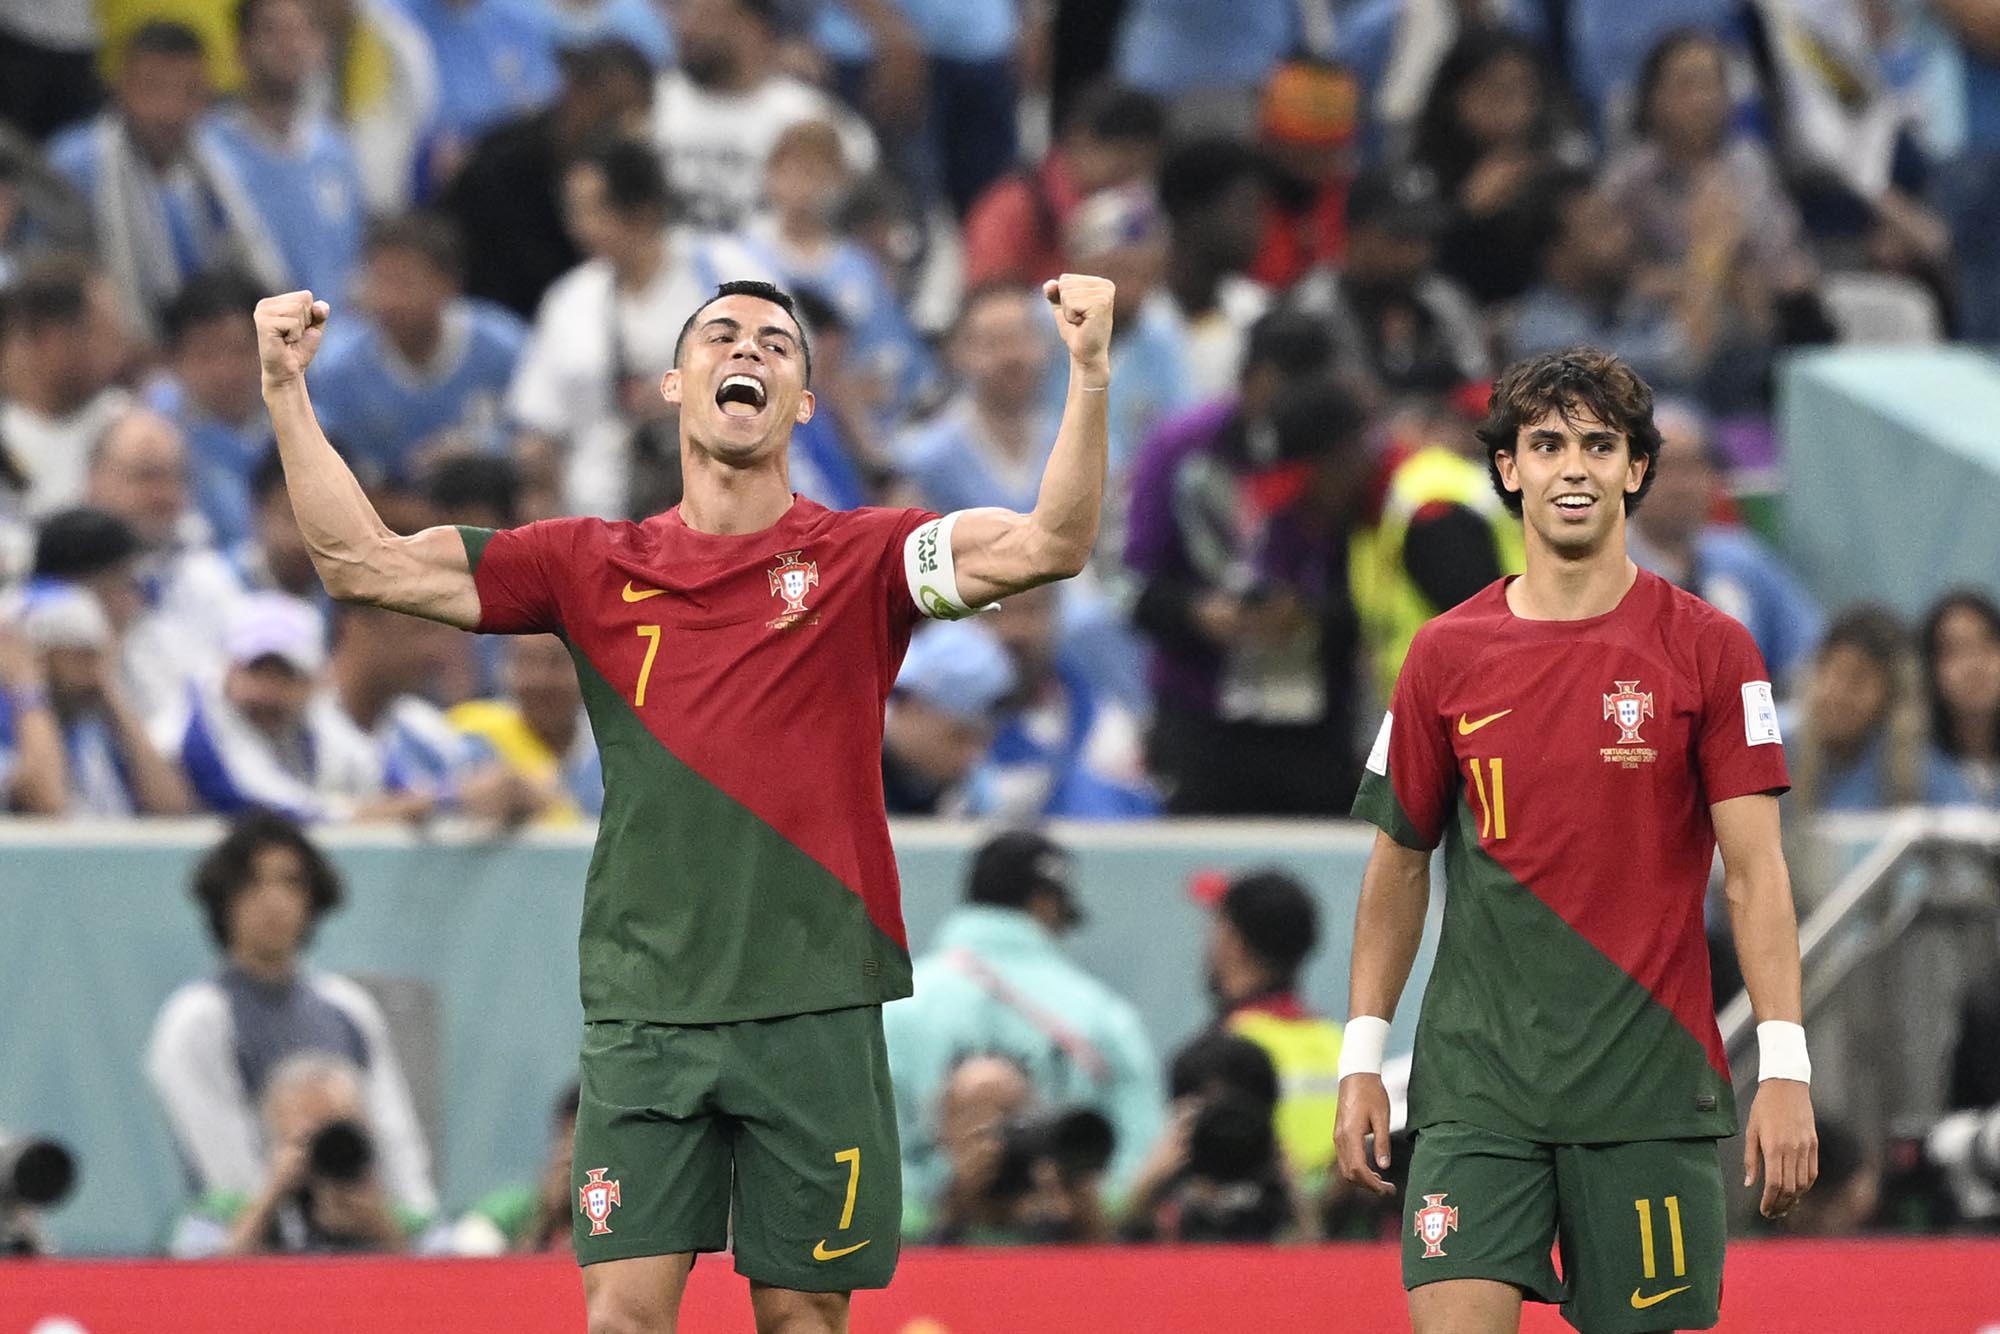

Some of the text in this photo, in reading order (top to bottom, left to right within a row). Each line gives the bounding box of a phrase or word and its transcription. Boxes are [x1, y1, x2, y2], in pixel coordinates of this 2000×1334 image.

[635, 625, 660, 706] 7
[1470, 758, 1507, 840] 11
[835, 1147, 860, 1230] 7
[1635, 1196, 1685, 1279] 11
